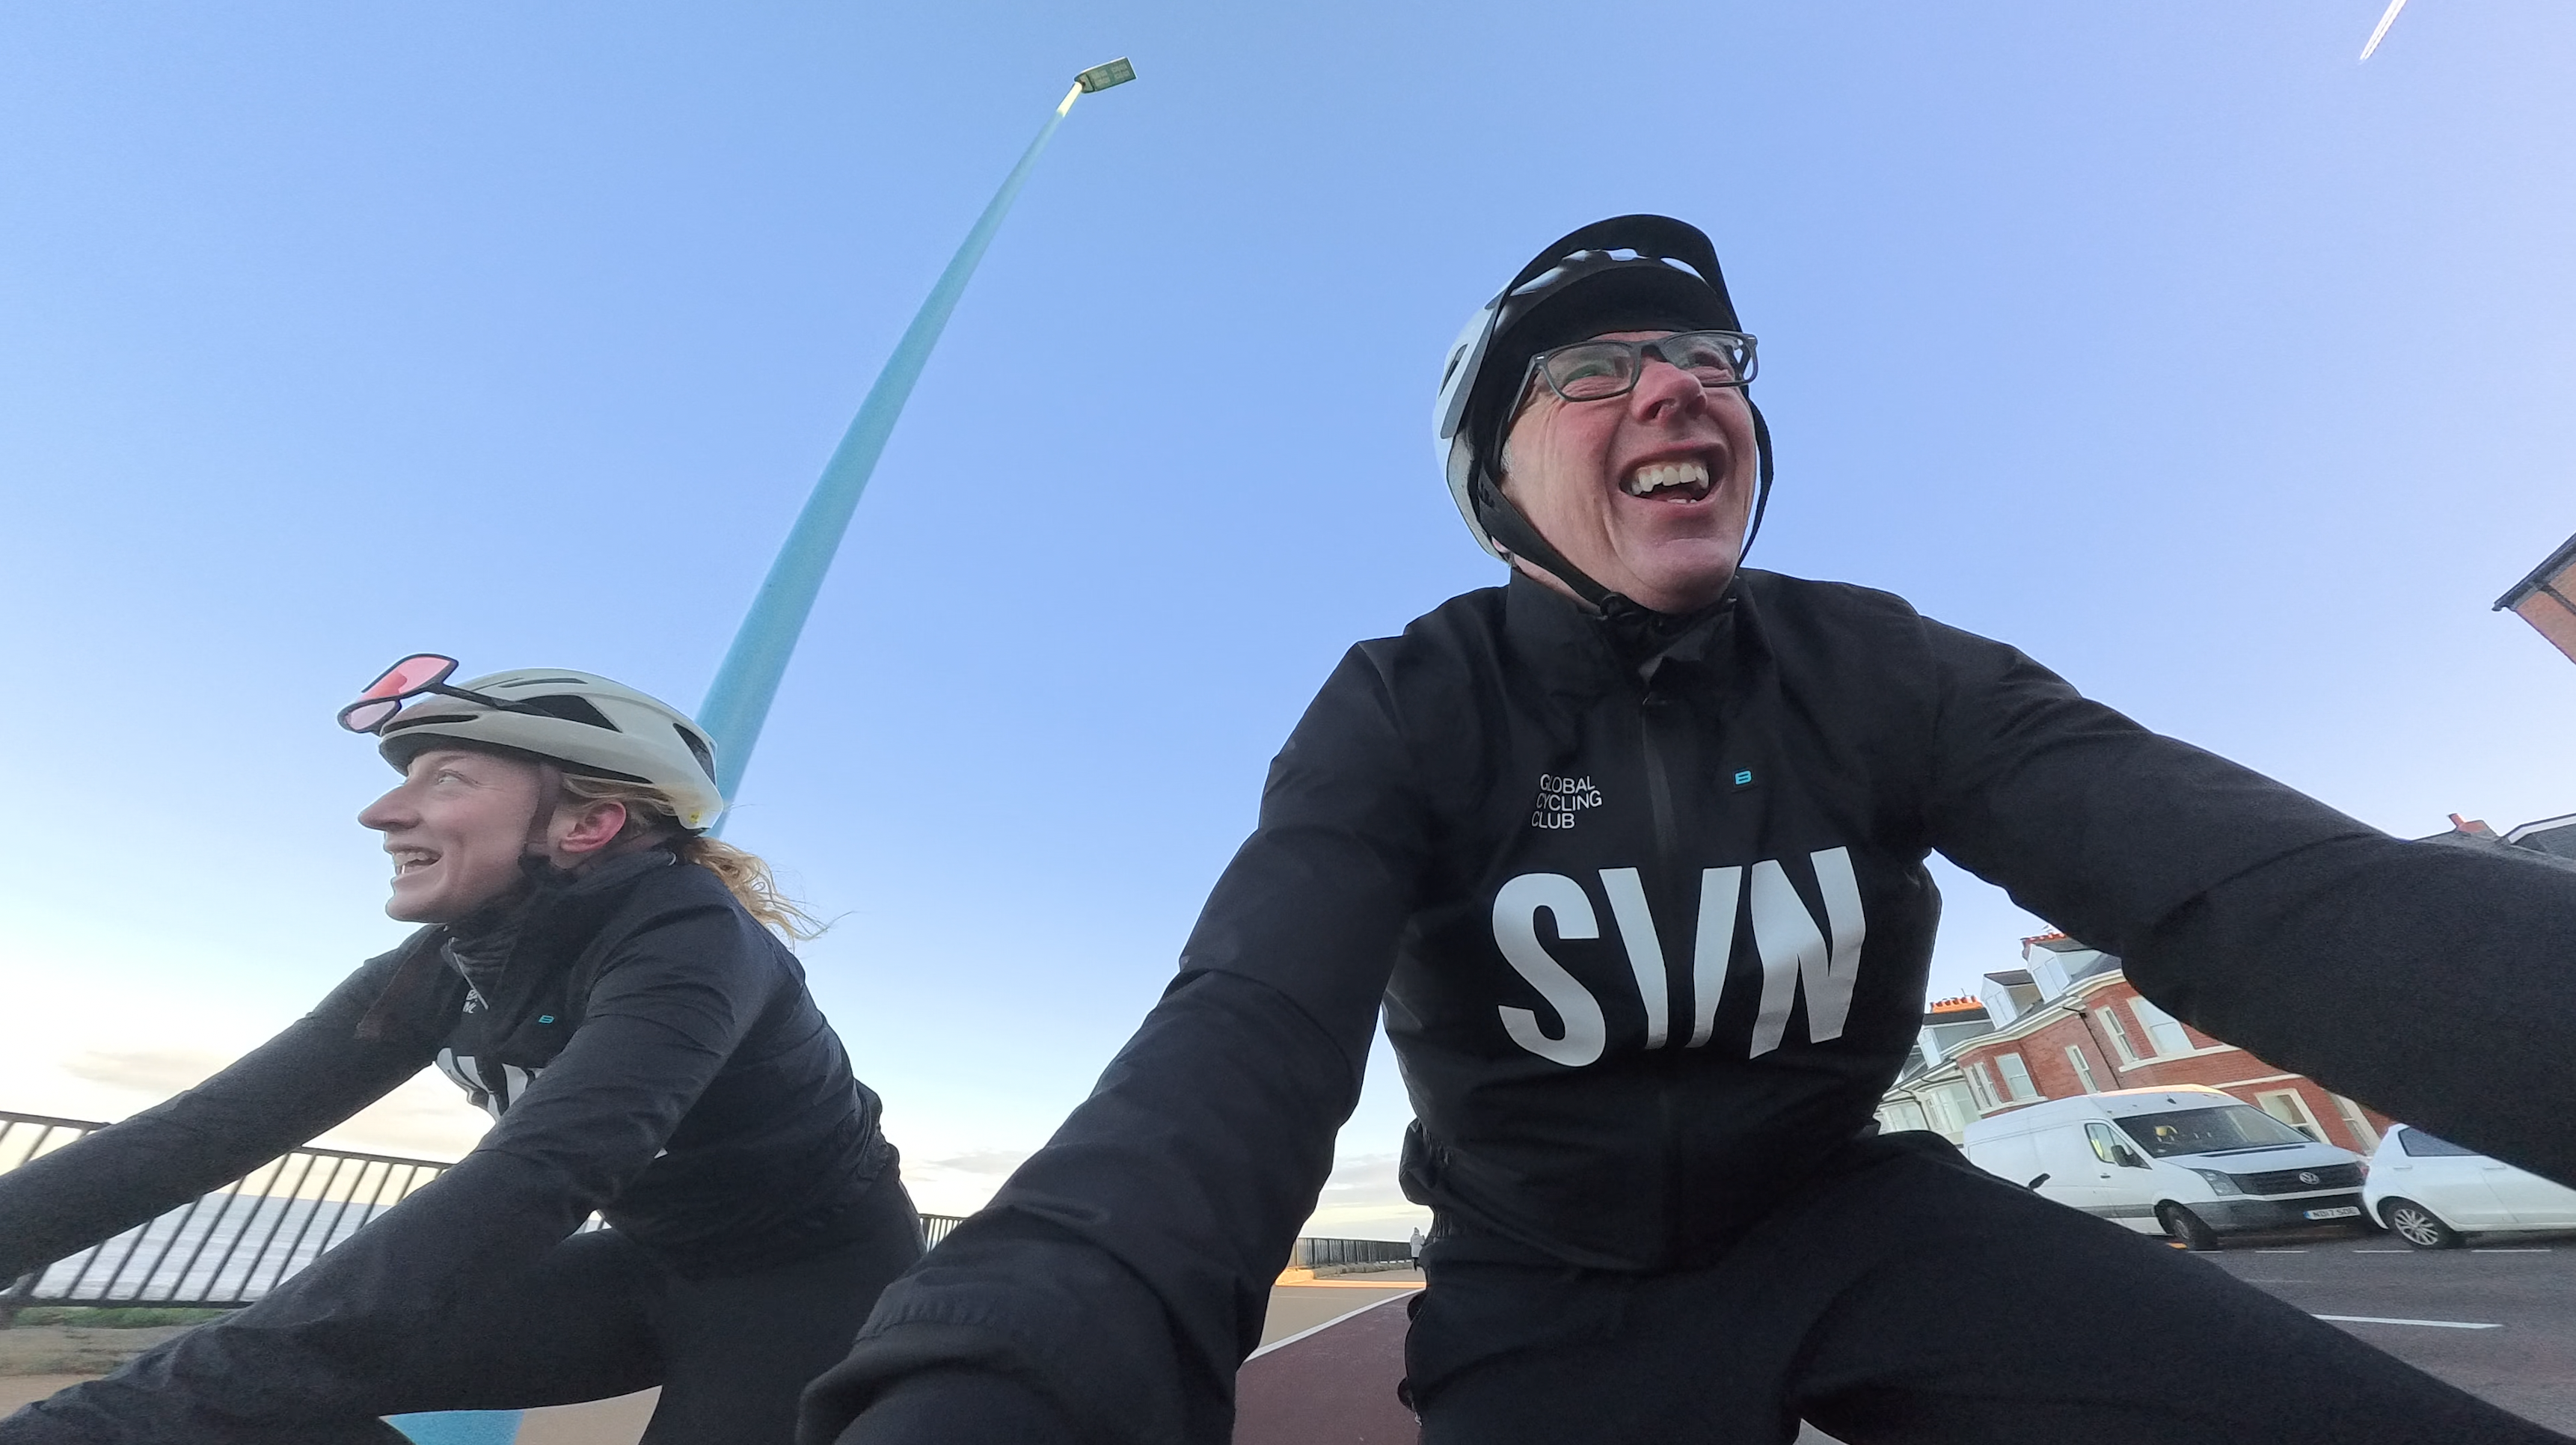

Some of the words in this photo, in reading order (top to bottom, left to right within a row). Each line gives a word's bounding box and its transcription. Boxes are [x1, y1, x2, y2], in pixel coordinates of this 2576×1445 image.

[1540, 773, 1596, 794] GLOBAL
[1536, 790, 1602, 812] CYCLING
[1531, 811, 1575, 829] CLUB
